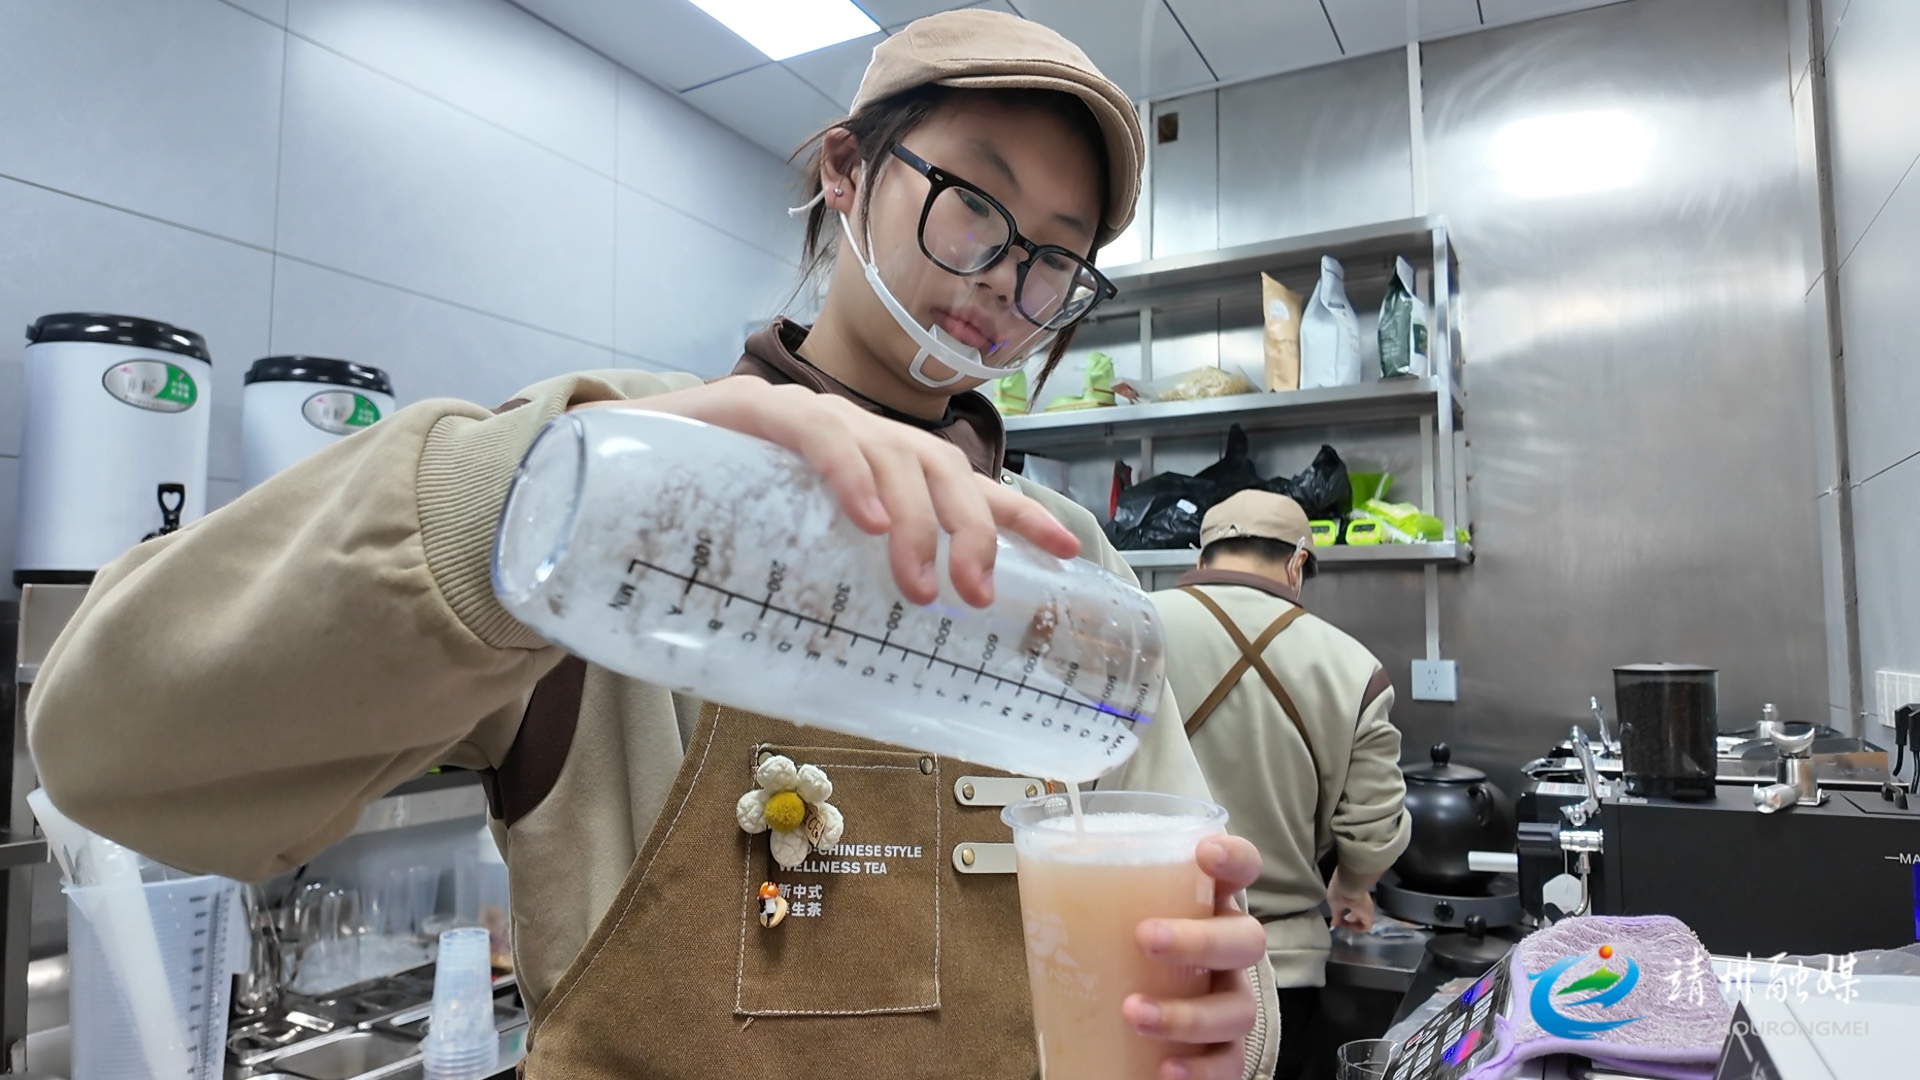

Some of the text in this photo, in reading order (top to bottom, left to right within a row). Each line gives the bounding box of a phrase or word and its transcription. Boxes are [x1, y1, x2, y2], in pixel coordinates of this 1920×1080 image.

[766, 559, 787, 592] 200
[831, 582, 851, 613] 300
[886, 601, 903, 631] 400
[741, 631, 757, 643] C
[934, 616, 952, 646] 500
[777, 640, 793, 653] D
[805, 650, 822, 661] E
[981, 633, 998, 660] 600
[1023, 647, 1040, 673] 700
[1101, 674, 1117, 699] 900
[884, 845, 922, 858] STYLE
[779, 860, 888, 874] WELLNESS TEA
[778, 883, 823, 900] 新中式
[786, 901, 822, 917] 生茶
